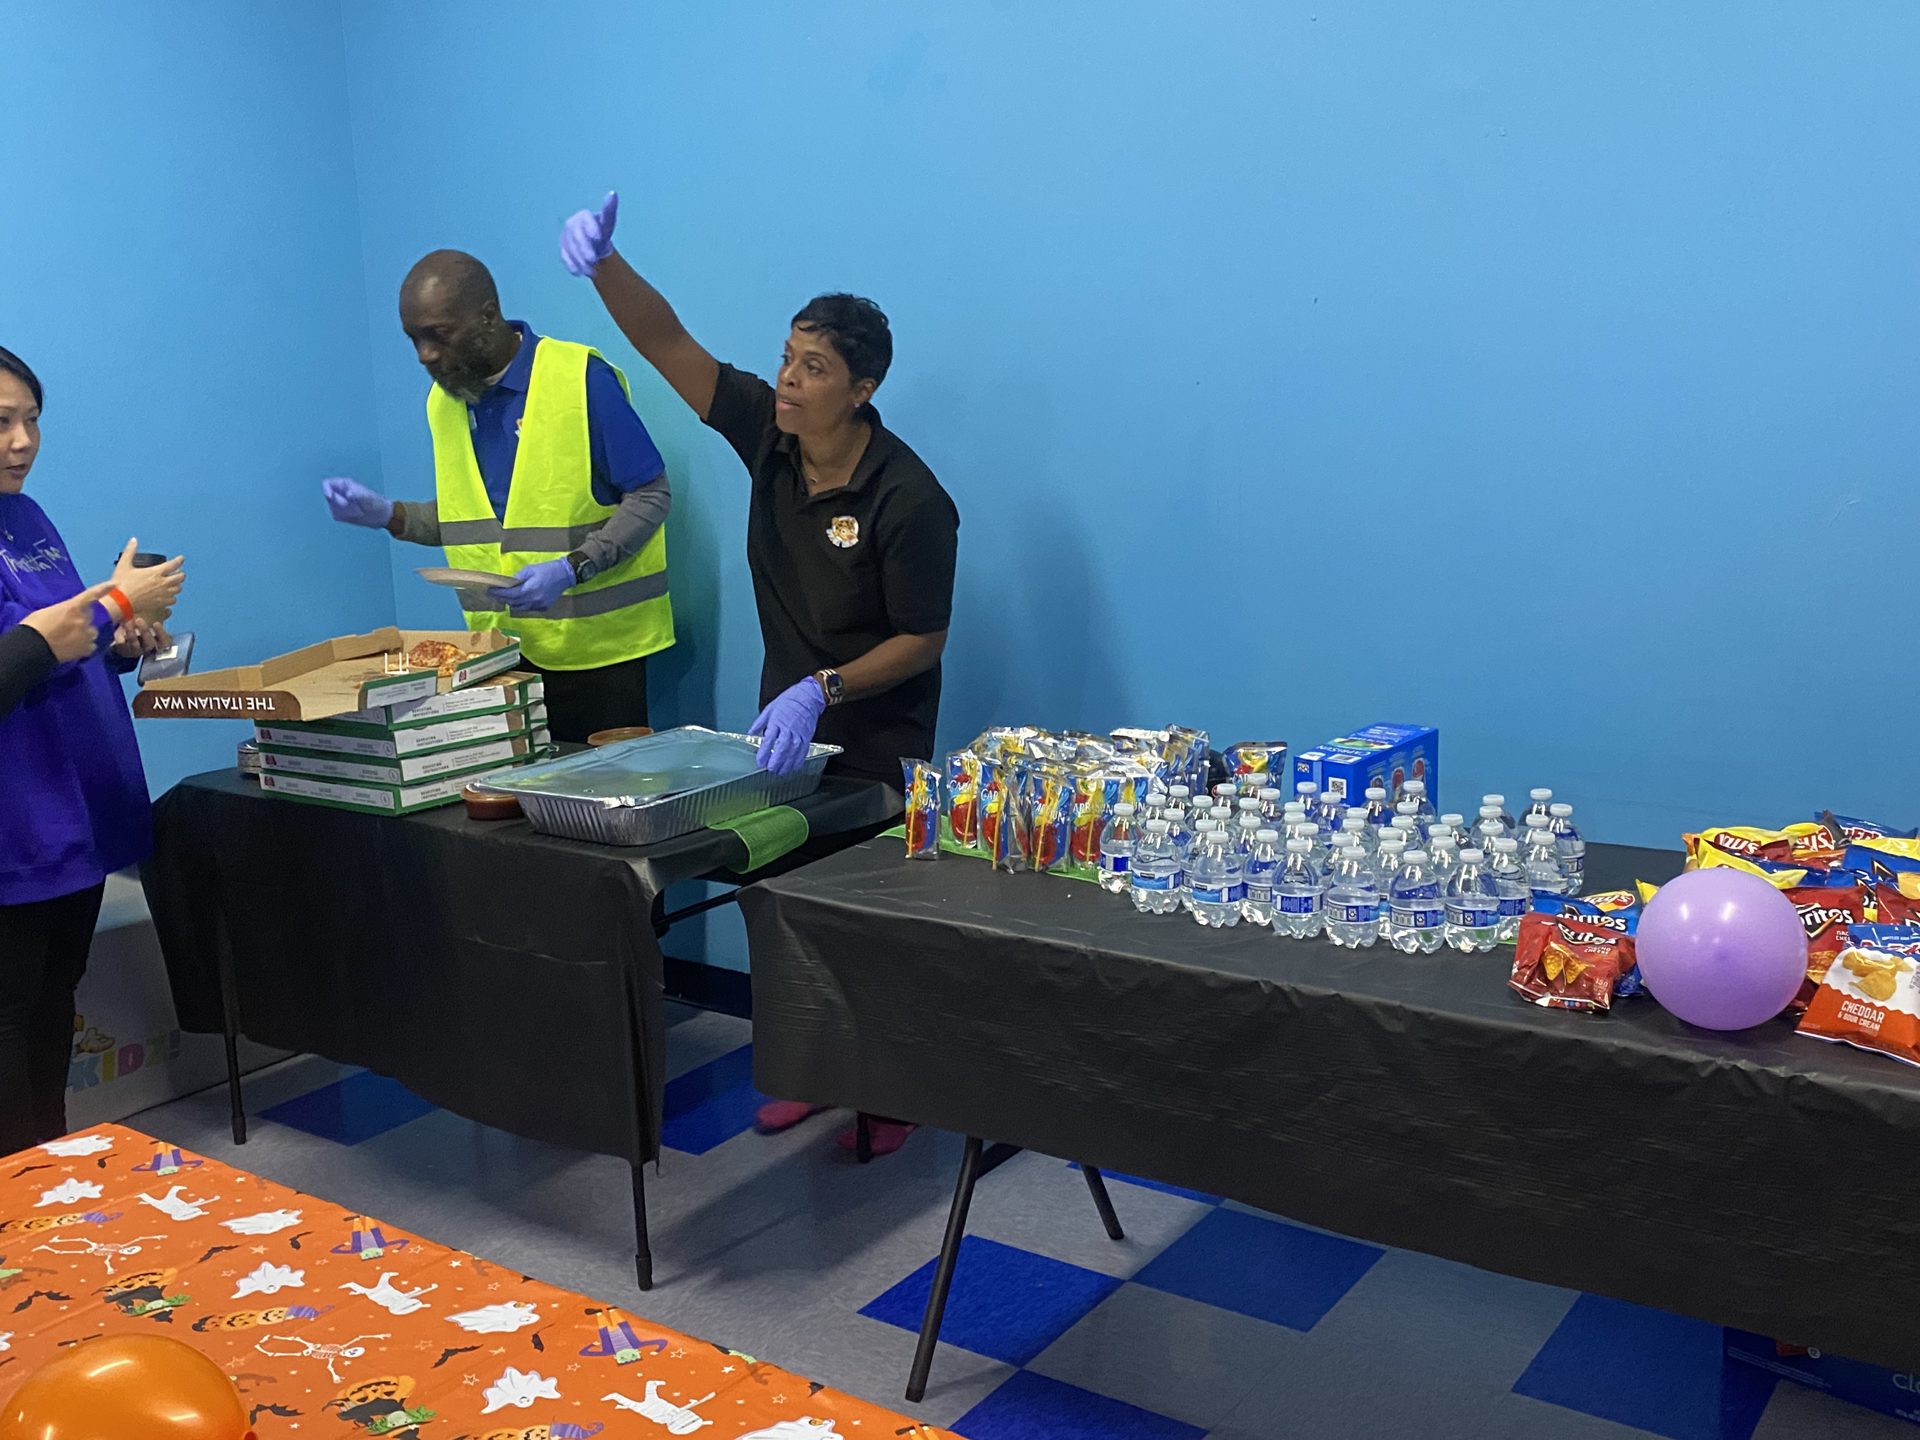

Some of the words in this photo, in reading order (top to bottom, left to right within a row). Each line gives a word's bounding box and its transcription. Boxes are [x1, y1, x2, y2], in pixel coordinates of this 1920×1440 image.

[153, 695, 185, 710] WAY
[186, 696, 243, 710] ITALIAN
[245, 696, 276, 711] THE
[1840, 1000, 1886, 1024] CHEDDAR
[1858, 1018, 1881, 1032] CREAM
